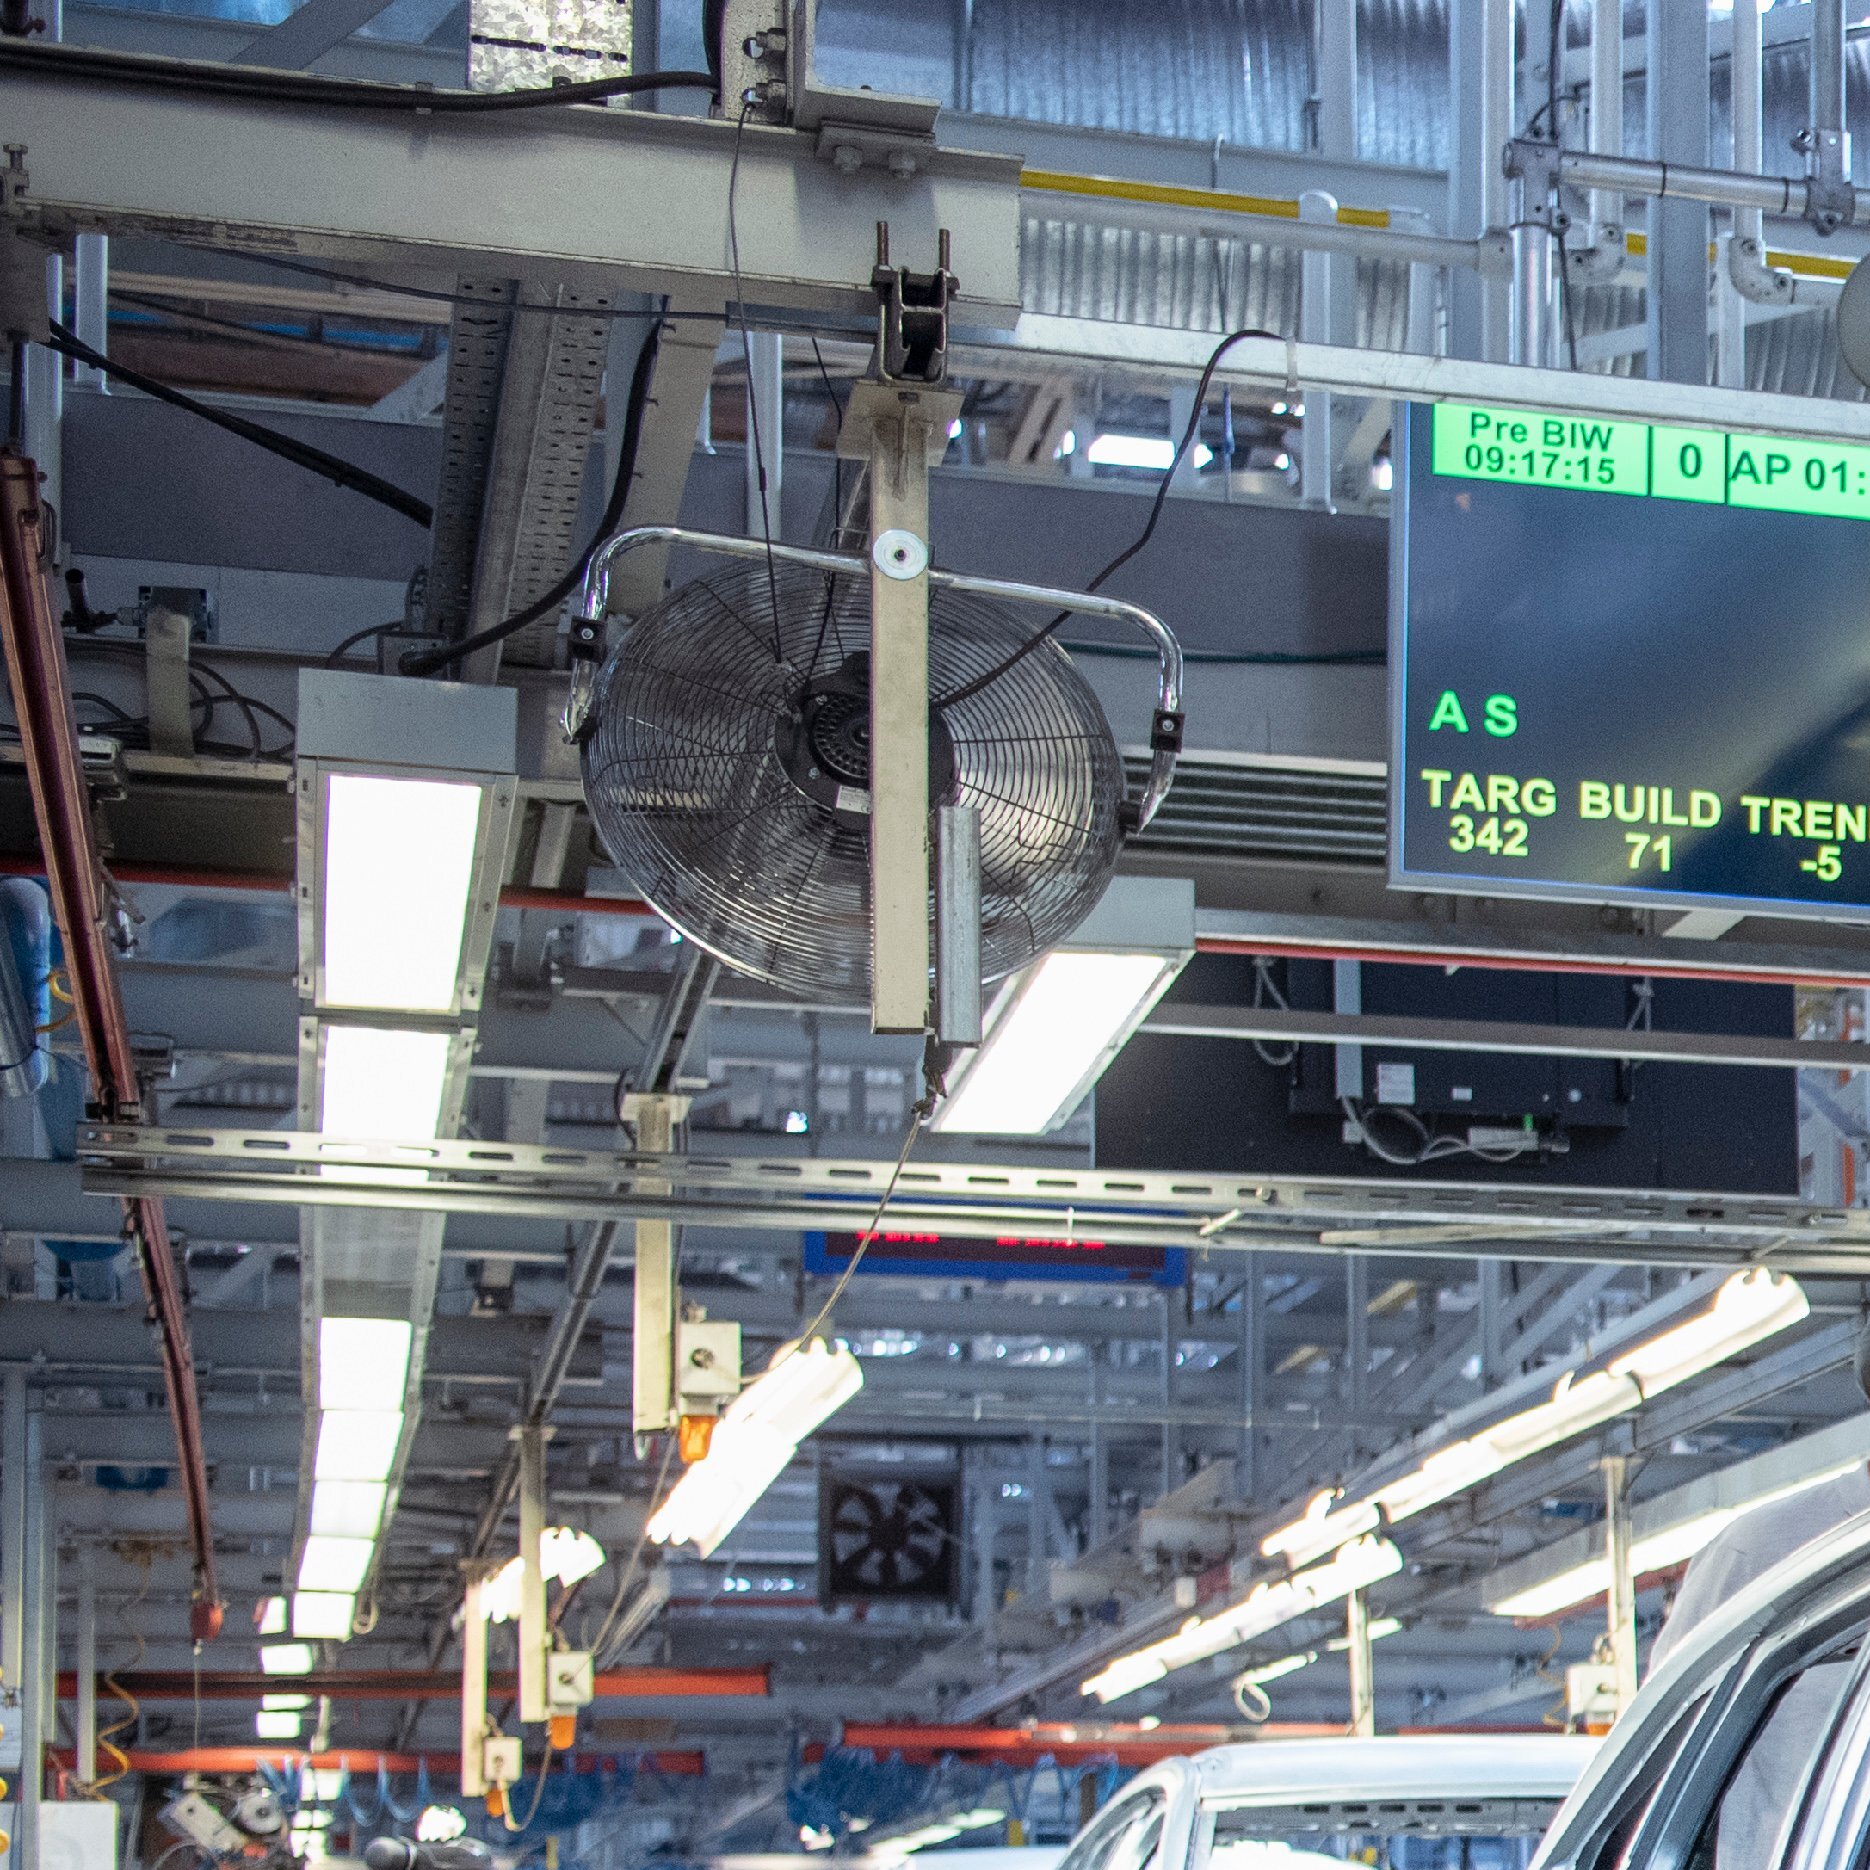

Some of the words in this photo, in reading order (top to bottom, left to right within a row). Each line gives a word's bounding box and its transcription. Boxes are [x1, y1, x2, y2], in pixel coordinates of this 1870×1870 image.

[1469, 412, 1527, 445] Pre
[1542, 420, 1613, 452] BIW
[1463, 445, 1616, 485] 09:17:15
[1678, 443, 1702, 479] 0
[1730, 450, 1791, 486] AP
[1420, 768, 1557, 818] TARG
[1578, 780, 1723, 829] BUILD
[1448, 813, 1529, 858] 342
[1624, 832, 1674, 872] 71
[1800, 844, 1843, 882] -5
